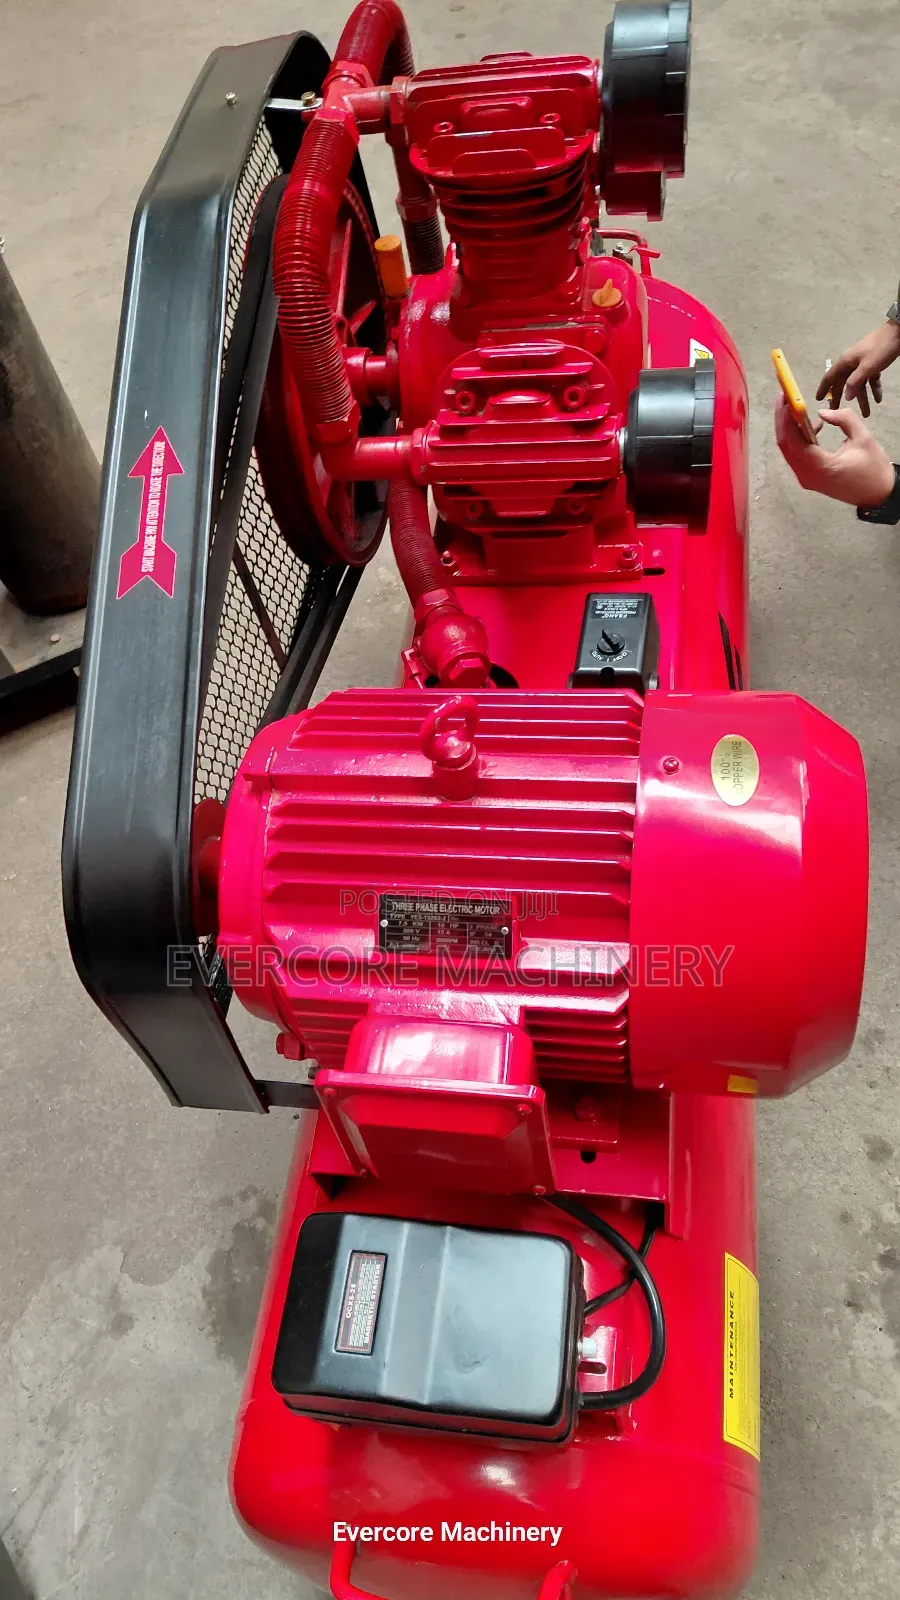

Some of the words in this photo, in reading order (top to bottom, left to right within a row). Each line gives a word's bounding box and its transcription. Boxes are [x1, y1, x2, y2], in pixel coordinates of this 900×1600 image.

[151, 467, 163, 477] THE
[148, 492, 161, 500] TO
[146, 500, 160, 525] ATTENTION
[143, 535, 156, 556] MACHINE
[141, 557, 154, 572] START
[732, 741, 742, 760] WIRE
[733, 761, 743, 794] OPPER
[392, 902, 414, 911] THREE
[416, 902, 438, 912] PHASE
[440, 903, 473, 914] ELECTRIC
[474, 905, 500, 915] MOTOR
[363, 1301, 374, 1343] MAGNETIC
[371, 1264, 380, 1300] STARTER
